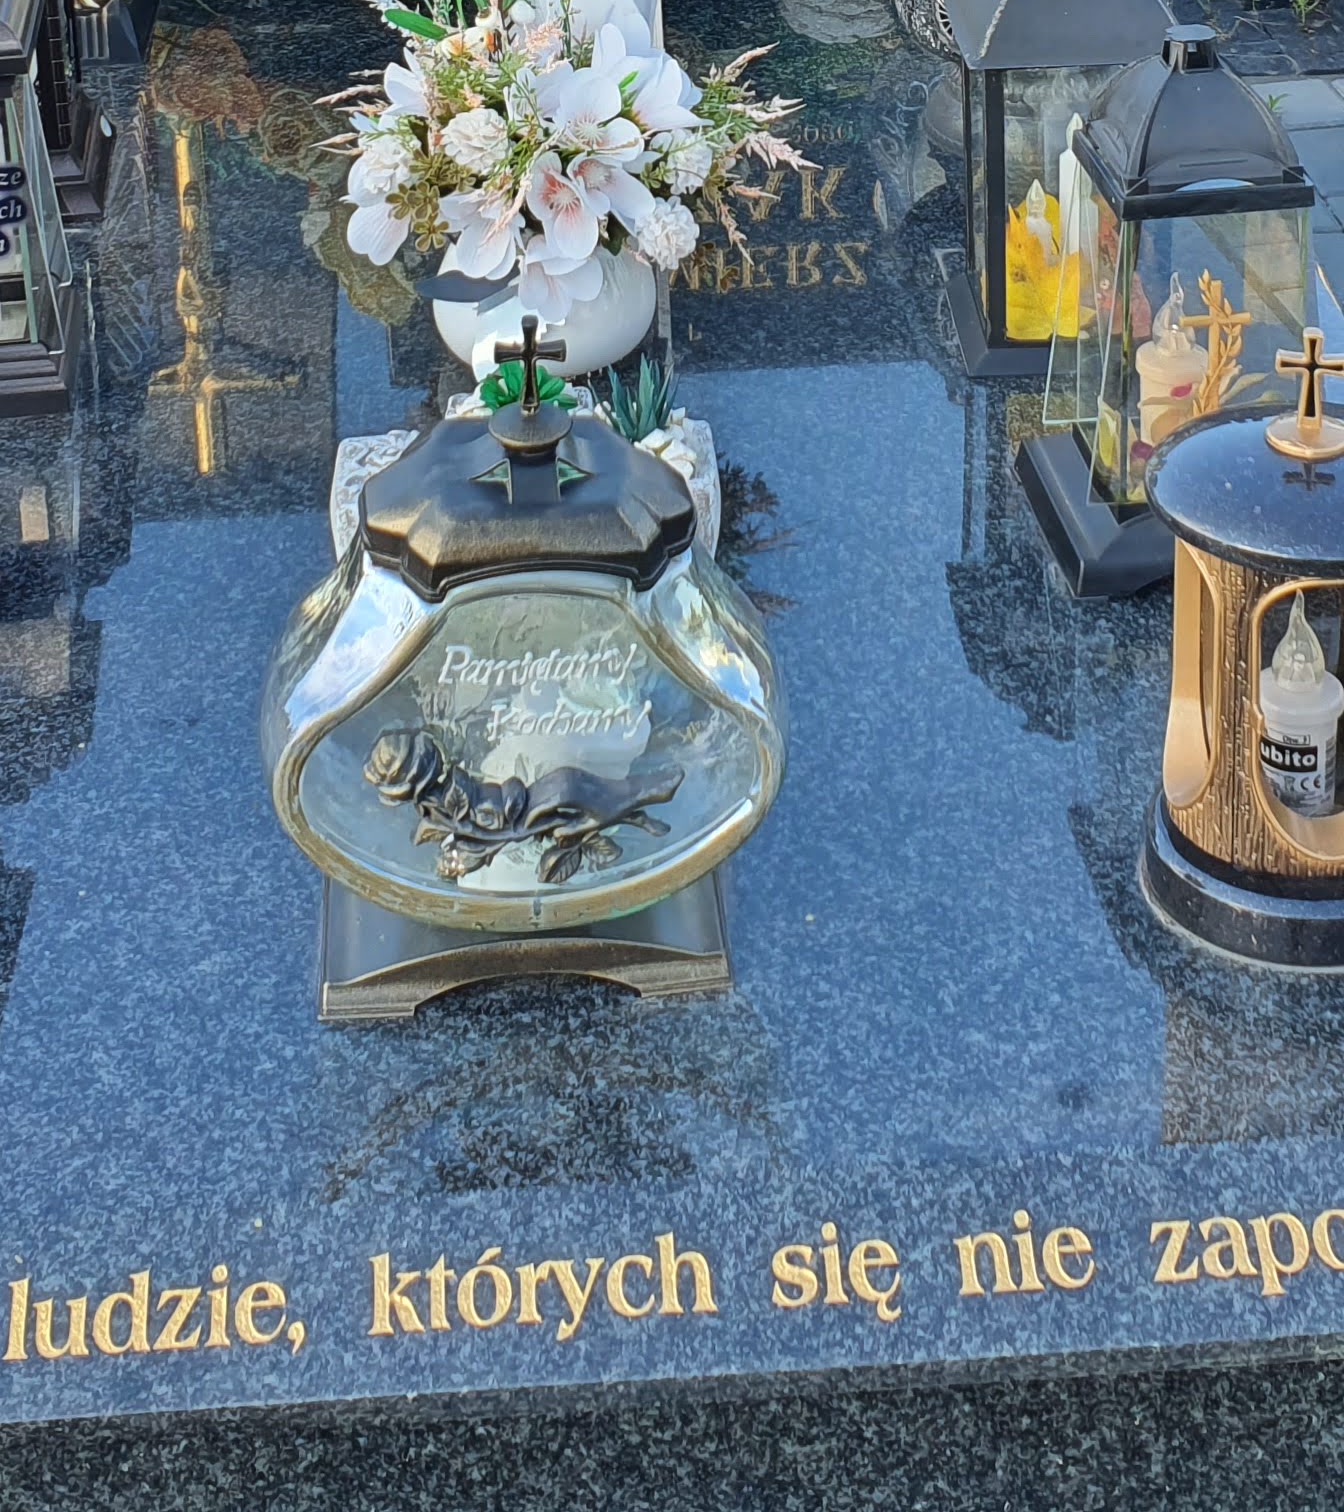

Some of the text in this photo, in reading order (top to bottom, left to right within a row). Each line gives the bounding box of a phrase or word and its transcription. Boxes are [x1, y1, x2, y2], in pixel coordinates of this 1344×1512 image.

[1260, 741, 1316, 767] ubito
[1, 1263, 306, 1361] ludzie,
[368, 1233, 719, 1341] których
[770, 1221, 902, 1322] się
[953, 1209, 1096, 1297] nie
